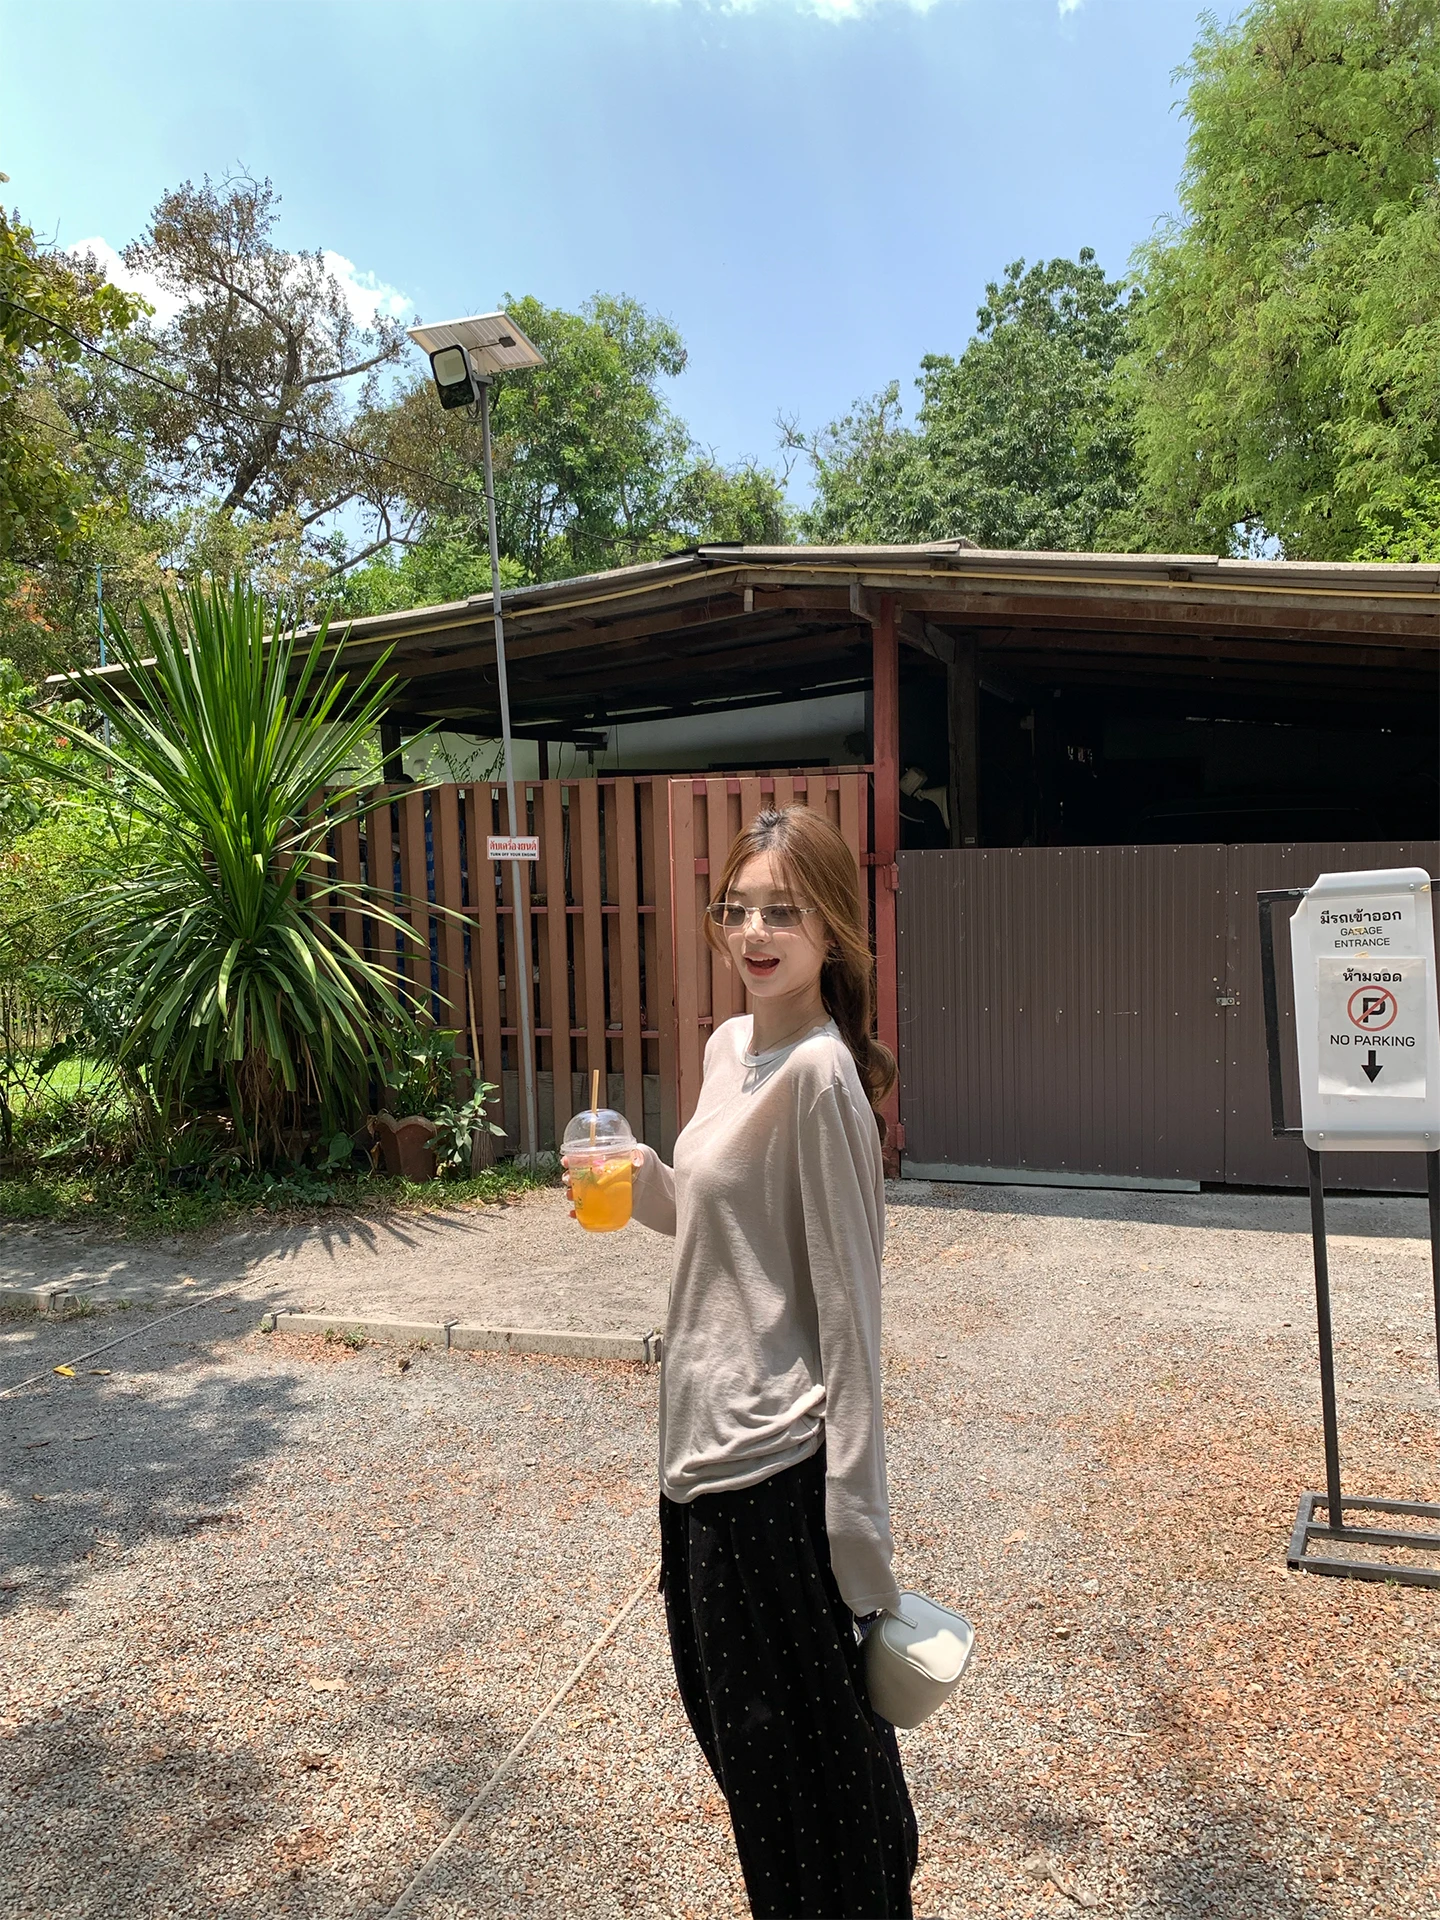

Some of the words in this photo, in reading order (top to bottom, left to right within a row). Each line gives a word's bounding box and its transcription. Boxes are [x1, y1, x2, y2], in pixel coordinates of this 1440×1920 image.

[1320, 908, 1402, 925] มีรถเข้าออก
[1334, 937, 1390, 948] ENTRANCE
[1343, 968, 1402, 982] ห้ามจอด
[1330, 1034, 1350, 1045] NO
[1354, 1035, 1416, 1047] PARKING
